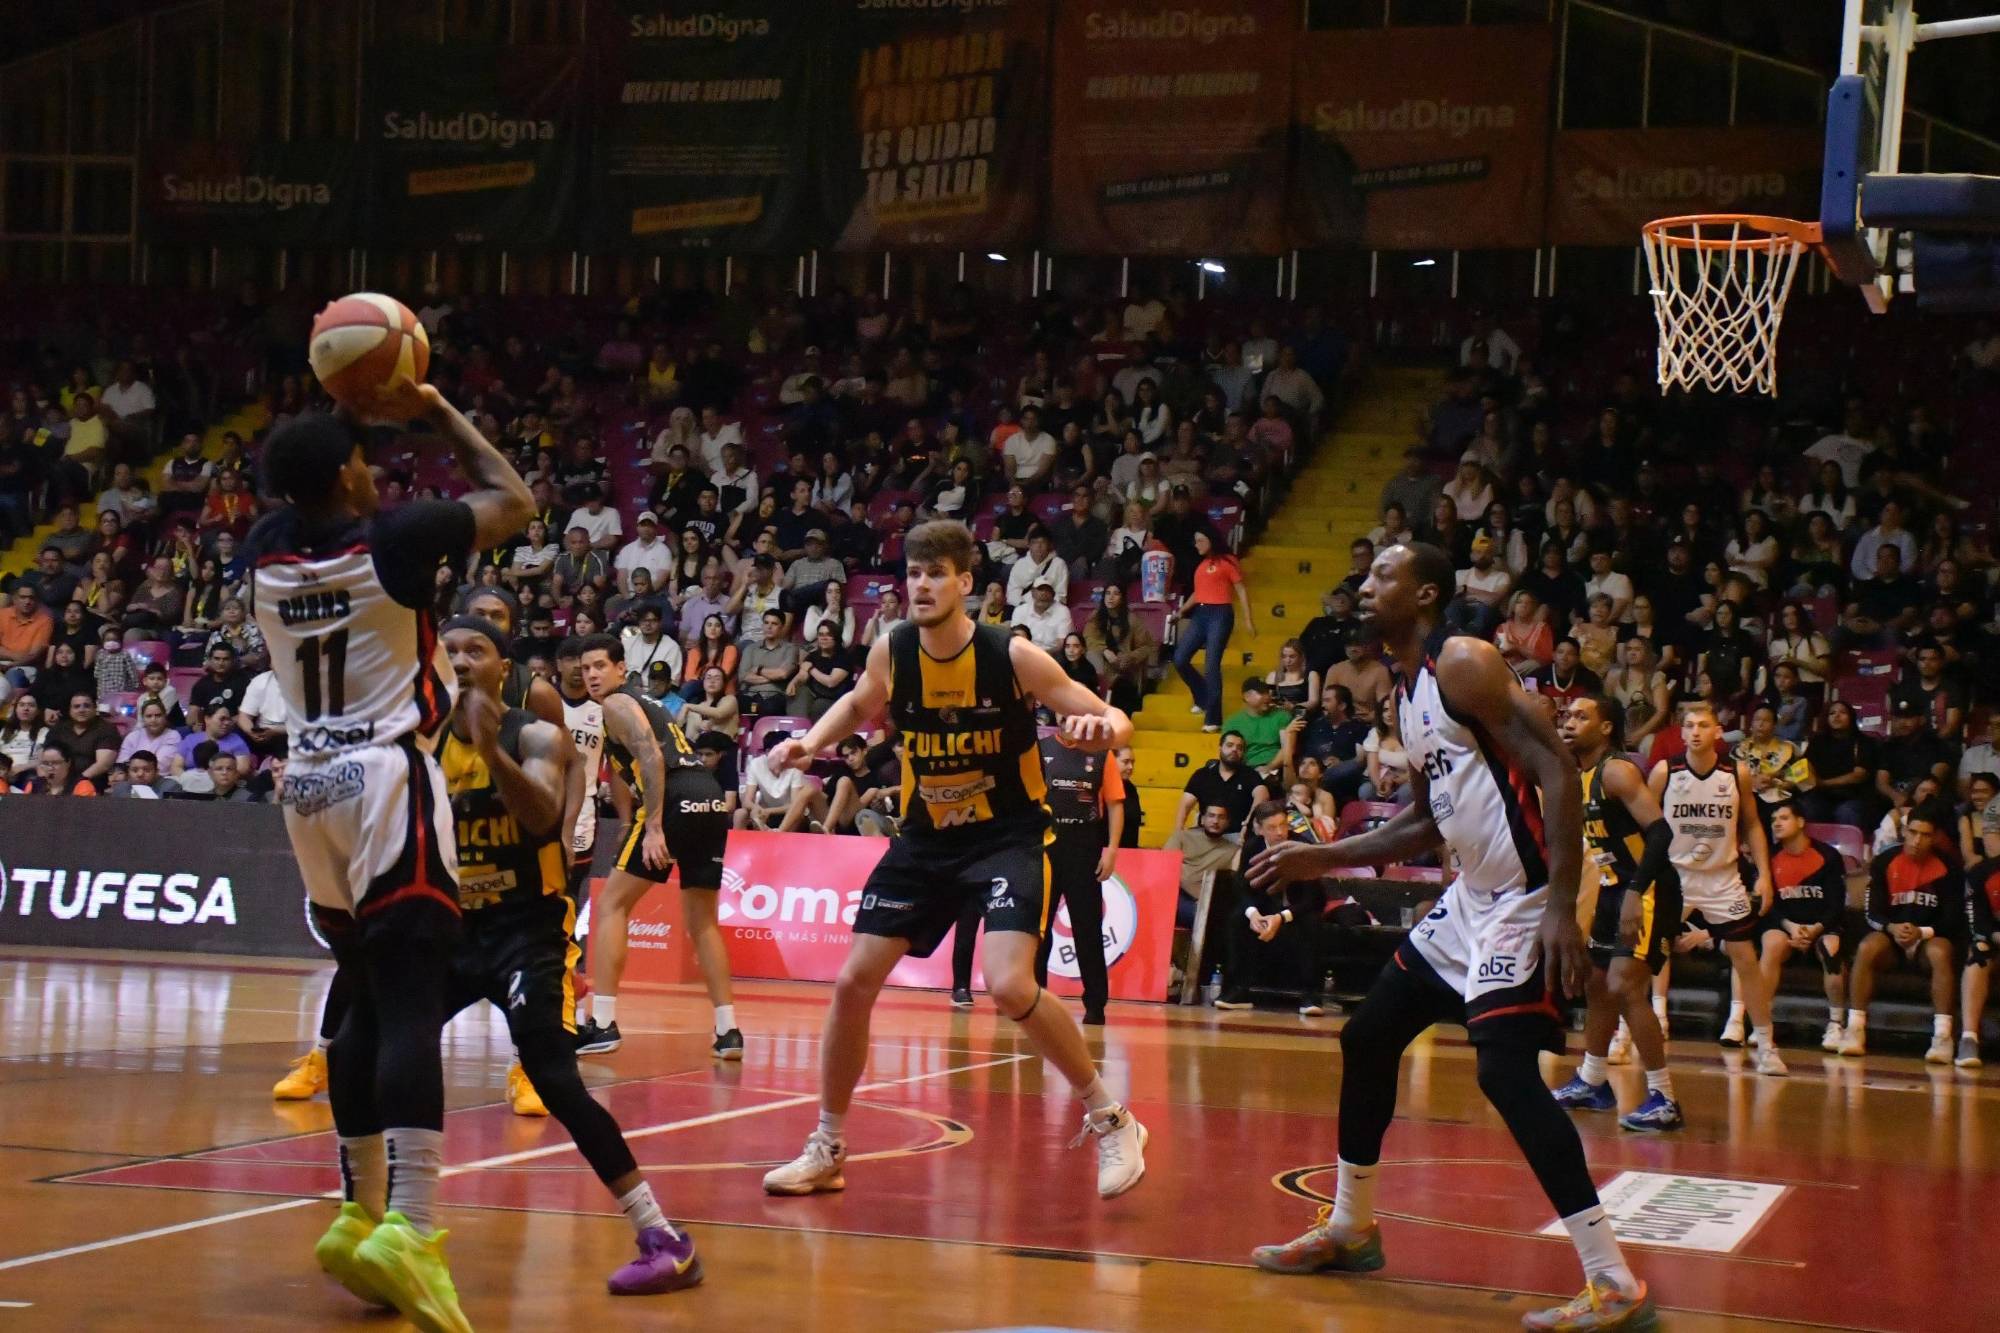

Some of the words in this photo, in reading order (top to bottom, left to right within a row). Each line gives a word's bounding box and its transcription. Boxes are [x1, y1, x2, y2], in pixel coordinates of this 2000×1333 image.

[630, 13, 769, 42] SaludDigna
[1084, 10, 1256, 43] SaludDigna
[1313, 99, 1516, 136] SaludDigna
[383, 111, 556, 148] SaludDigna
[162, 172, 331, 211] SaludDigna
[1571, 165, 1787, 204] SaludDigna
[1271, 604, 1285, 618] G
[1243, 653, 1253, 665] F
[296, 627, 349, 722] 11
[1175, 753, 1189, 767] D
[680, 799, 710, 814] Soni
[711, 799, 728, 813] Ga
[1672, 804, 1733, 819] ZONKEYS
[458, 816, 520, 847] ICHI
[460, 851, 484, 862] WN
[11, 868, 236, 925] TUFESA
[719, 868, 863, 926] oma
[1778, 885, 1825, 900] ZONKEYS
[1891, 890, 1938, 908] ZONEYS
[628, 919, 671, 937] liente
[735, 928, 783, 941] COLOR
[823, 933, 853, 944] INN
[1418, 922, 1436, 940] GA
[1059, 926, 1118, 964] Bel
[1478, 956, 1516, 977] abc
